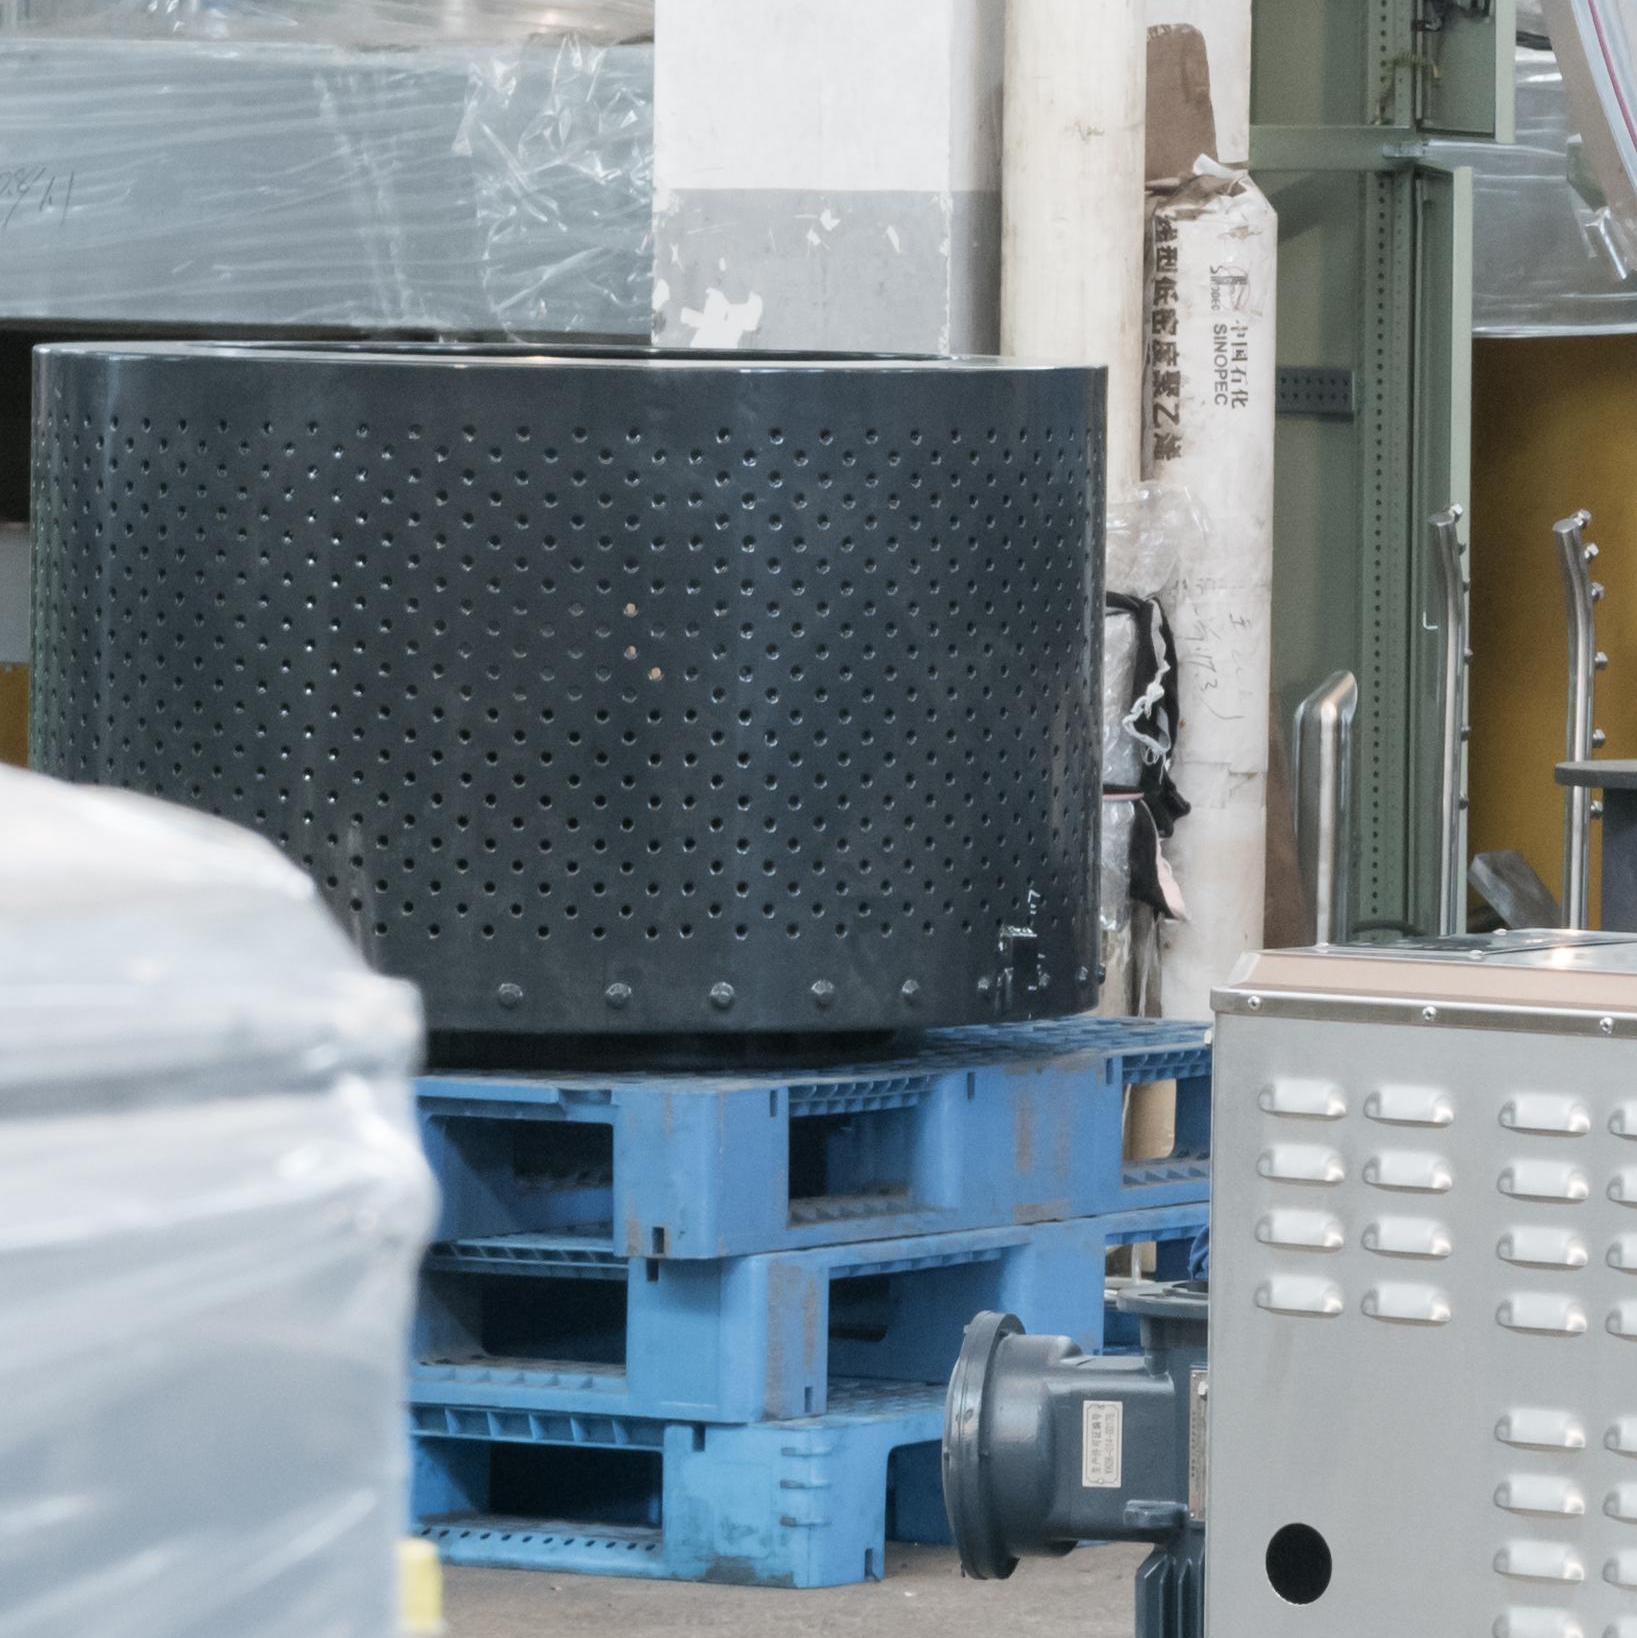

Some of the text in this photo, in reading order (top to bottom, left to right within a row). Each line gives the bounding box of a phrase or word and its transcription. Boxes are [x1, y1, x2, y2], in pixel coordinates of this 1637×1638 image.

[1213, 323, 1229, 406] SINOPEC
[1230, 320, 1249, 409] 中国石化
